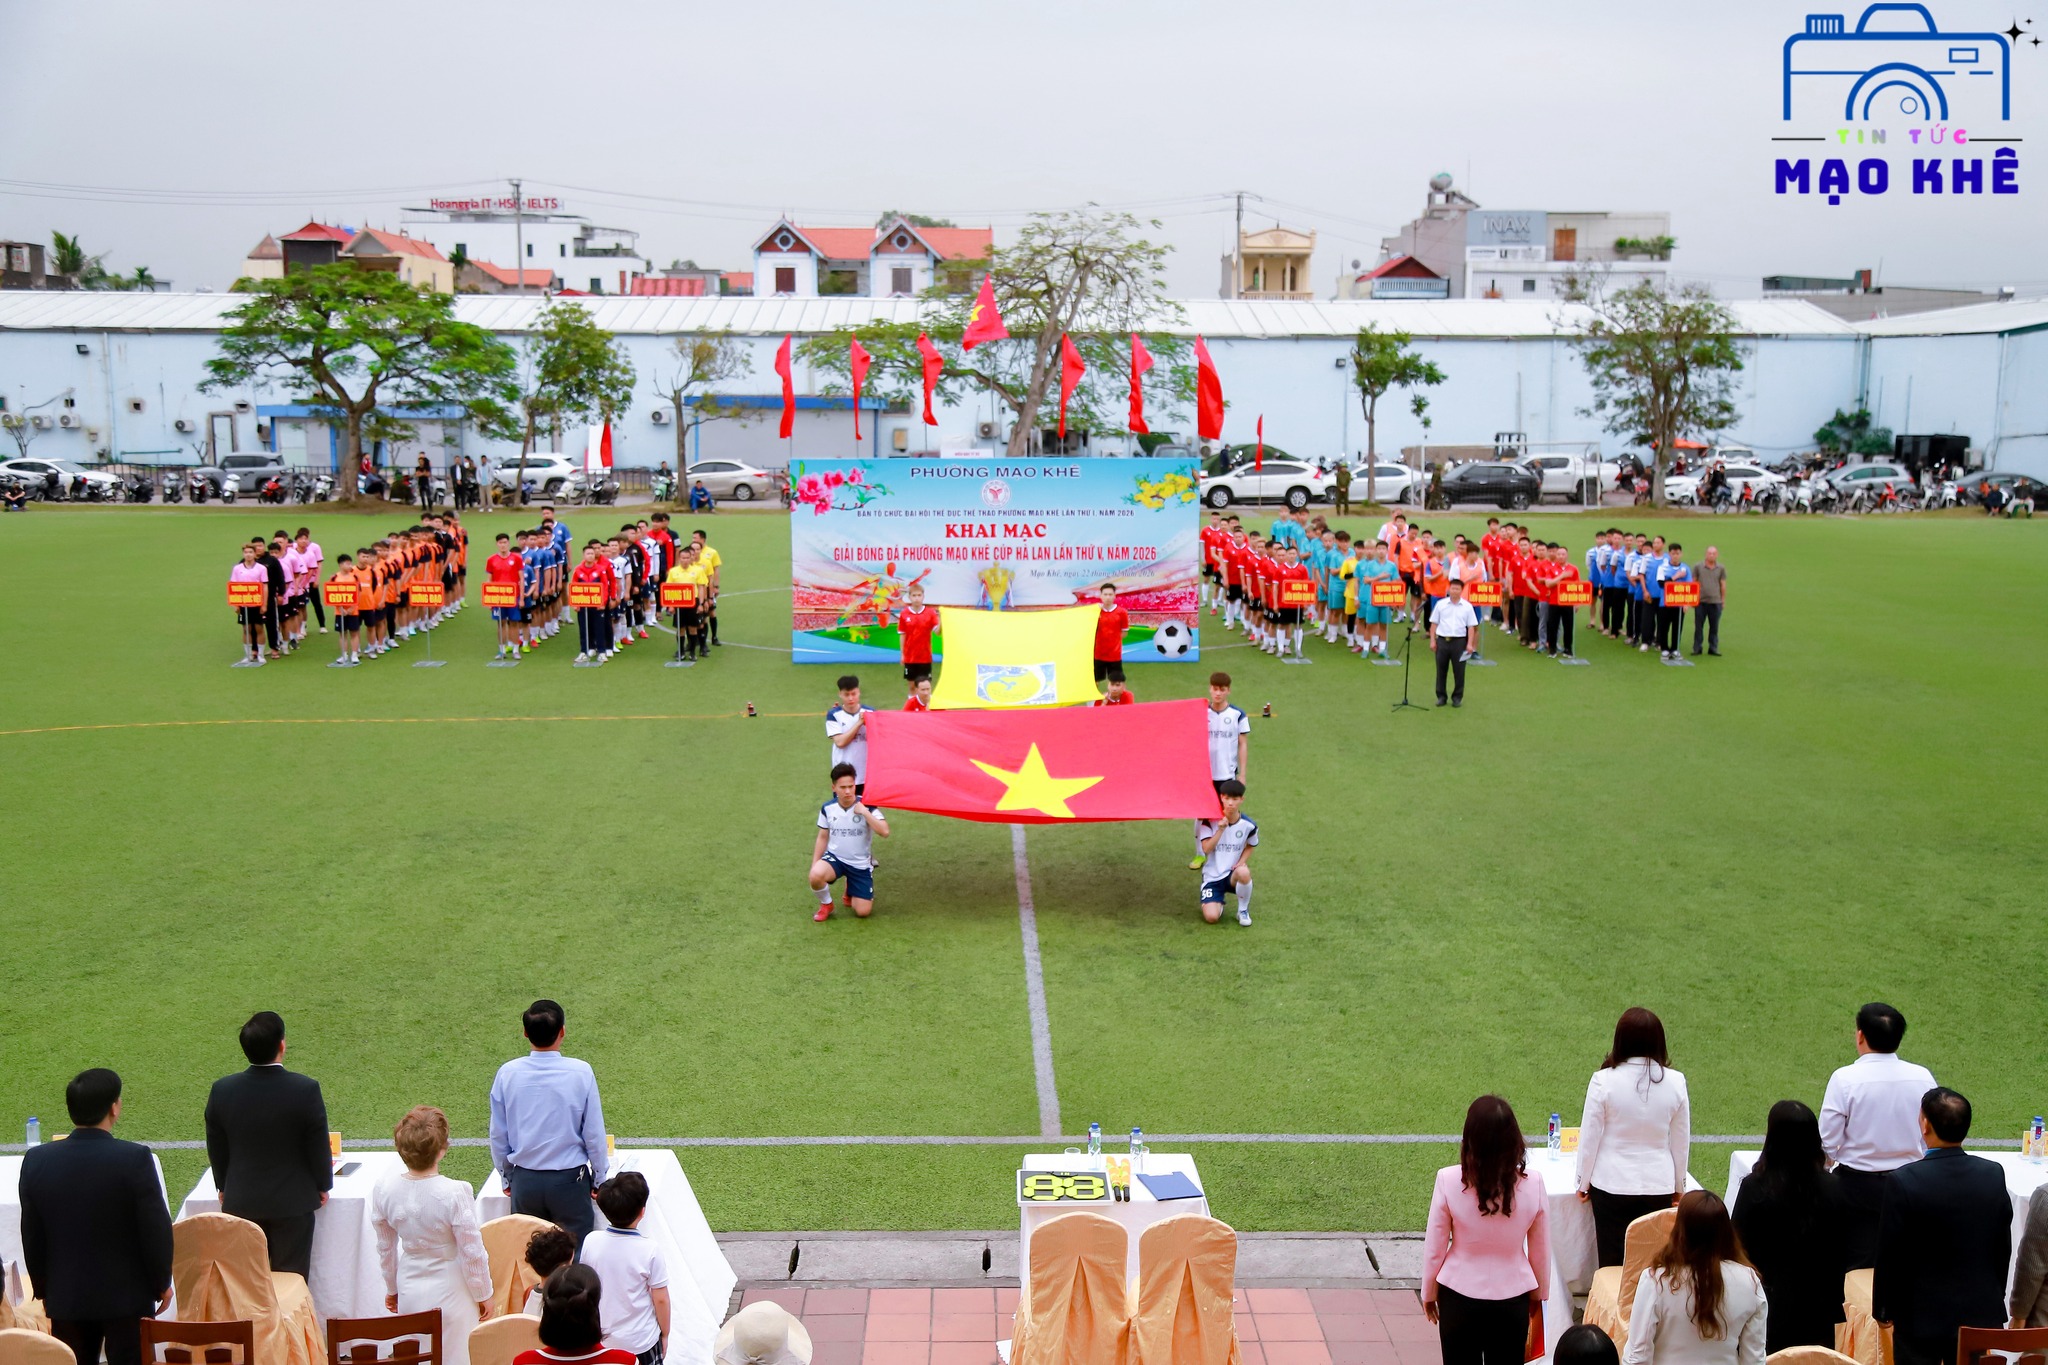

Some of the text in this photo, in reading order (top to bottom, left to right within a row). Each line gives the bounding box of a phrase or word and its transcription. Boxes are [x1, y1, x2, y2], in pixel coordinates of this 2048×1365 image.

[431, 199, 479, 210] Hoanggia
[482, 199, 491, 208] IT
[528, 198, 558, 208] IELTS
[1484, 216, 1530, 234] INAX
[911, 464, 1080, 479] PHƯỜNG MẠO KHÊ
[945, 524, 1047, 542] KHAI MẠC
[834, 543, 854, 561] GIẢI
[857, 545, 884, 561] BÓNG
[887, 545, 900, 561] ĐÁ
[903, 545, 943, 561] PHƯỜNG
[946, 547, 968, 563] MẠO
[971, 545, 990, 561] KHÊ
[993, 545, 1012, 561] CÚP
[1032, 547, 1050, 561] LAN
[1076, 545, 1095, 561] THỨ
[1107, 545, 1130, 561] NĂM
[1133, 547, 1156, 561] 2026
[329, 594, 354, 603] GDTX
